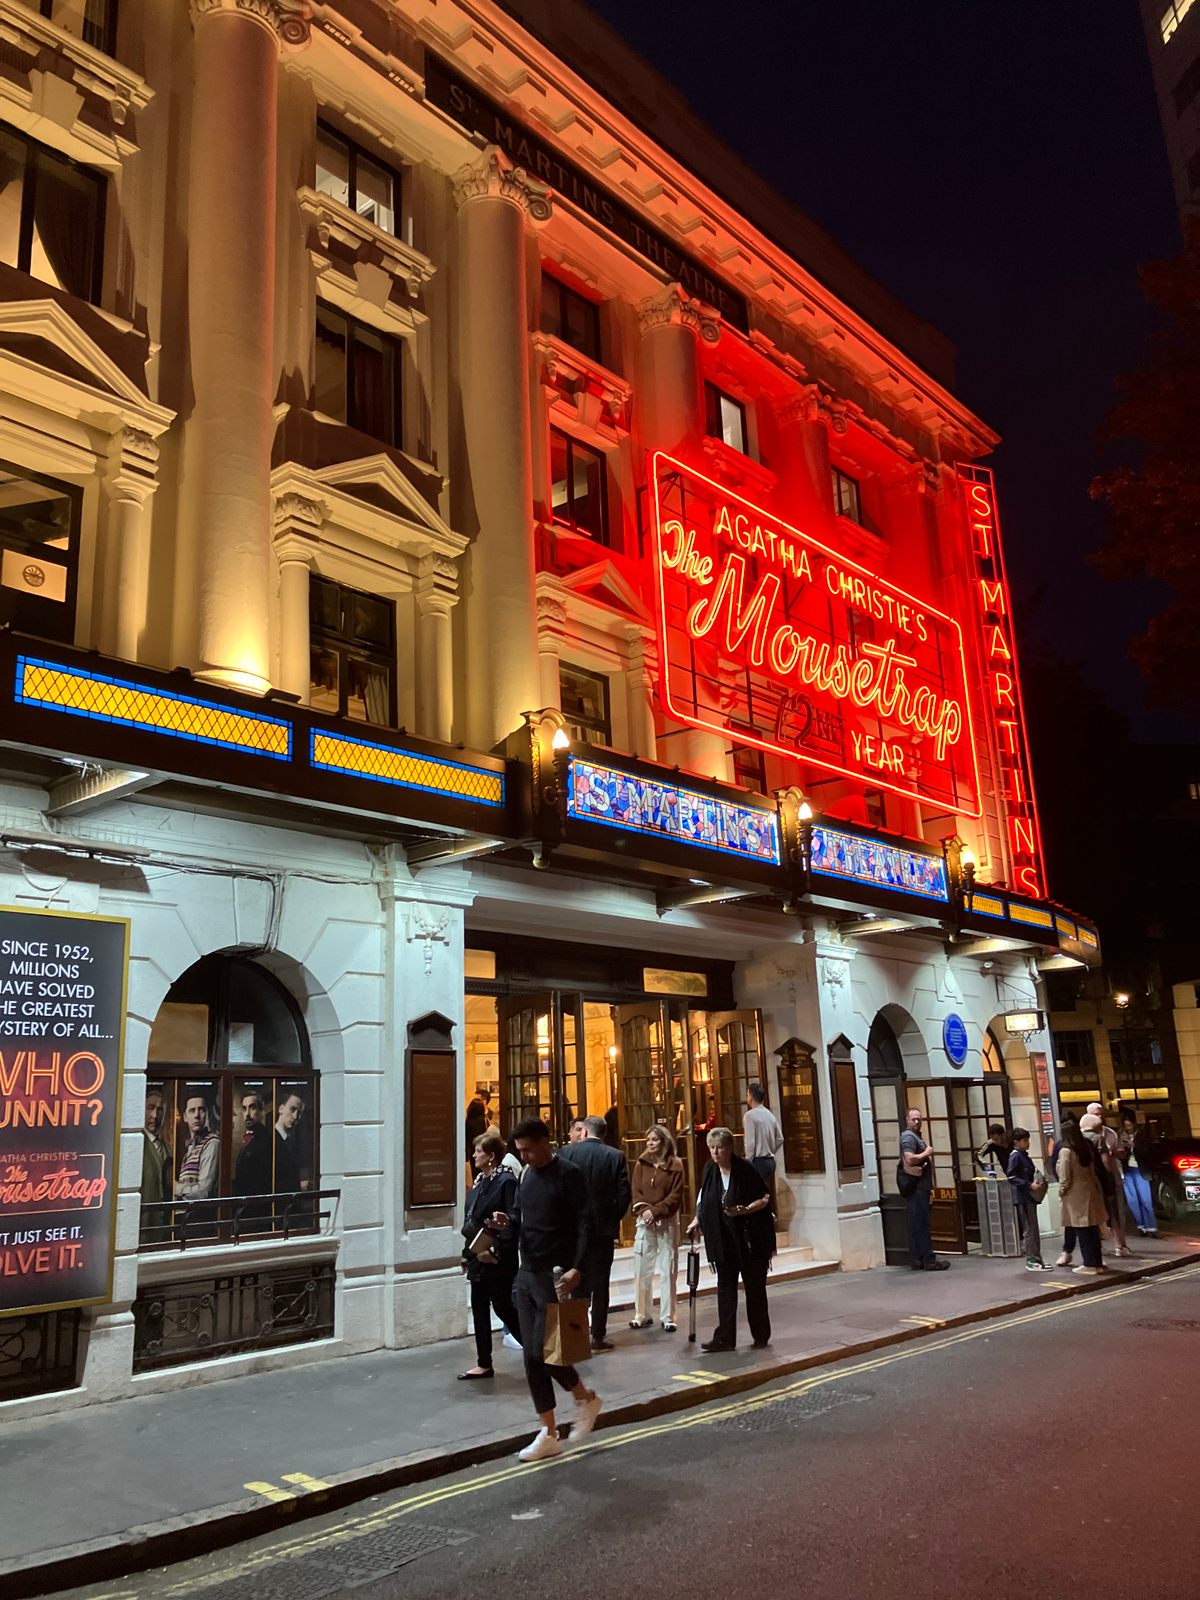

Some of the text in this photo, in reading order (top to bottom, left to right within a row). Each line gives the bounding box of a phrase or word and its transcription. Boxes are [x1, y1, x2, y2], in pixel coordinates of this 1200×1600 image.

[495, 116, 614, 226] MARTINS
[631, 221, 729, 313] THEATRE
[662, 519, 714, 586] The
[716, 506, 928, 642] AGATHA CHRISTIE'S
[687, 552, 962, 761] Mousetrap
[971, 485, 1039, 899] ST MARTINS
[851, 729, 905, 775] YEAR
[627, 782, 762, 850] MARTINS
[1, 940, 94, 964] SINCE 1952,
[9, 961, 79, 978] MILLIONS
[37, 982, 95, 999] SOLVED
[21, 1001, 95, 1018] GREATEST
[52, 1022, 75, 1037] OF
[78, 1023, 114, 1039] ALL...
[0, 1151, 78, 1164] ATHA CHRISTIE'S
[4, 1164, 29, 1183] The
[940, 1188, 958, 1199] BAR
[12, 1229, 42, 1246] JUST
[44, 1227, 67, 1242] SEE
[70, 1226, 84, 1239] IT.
[0, 1243, 84, 1276] LVE IT.
